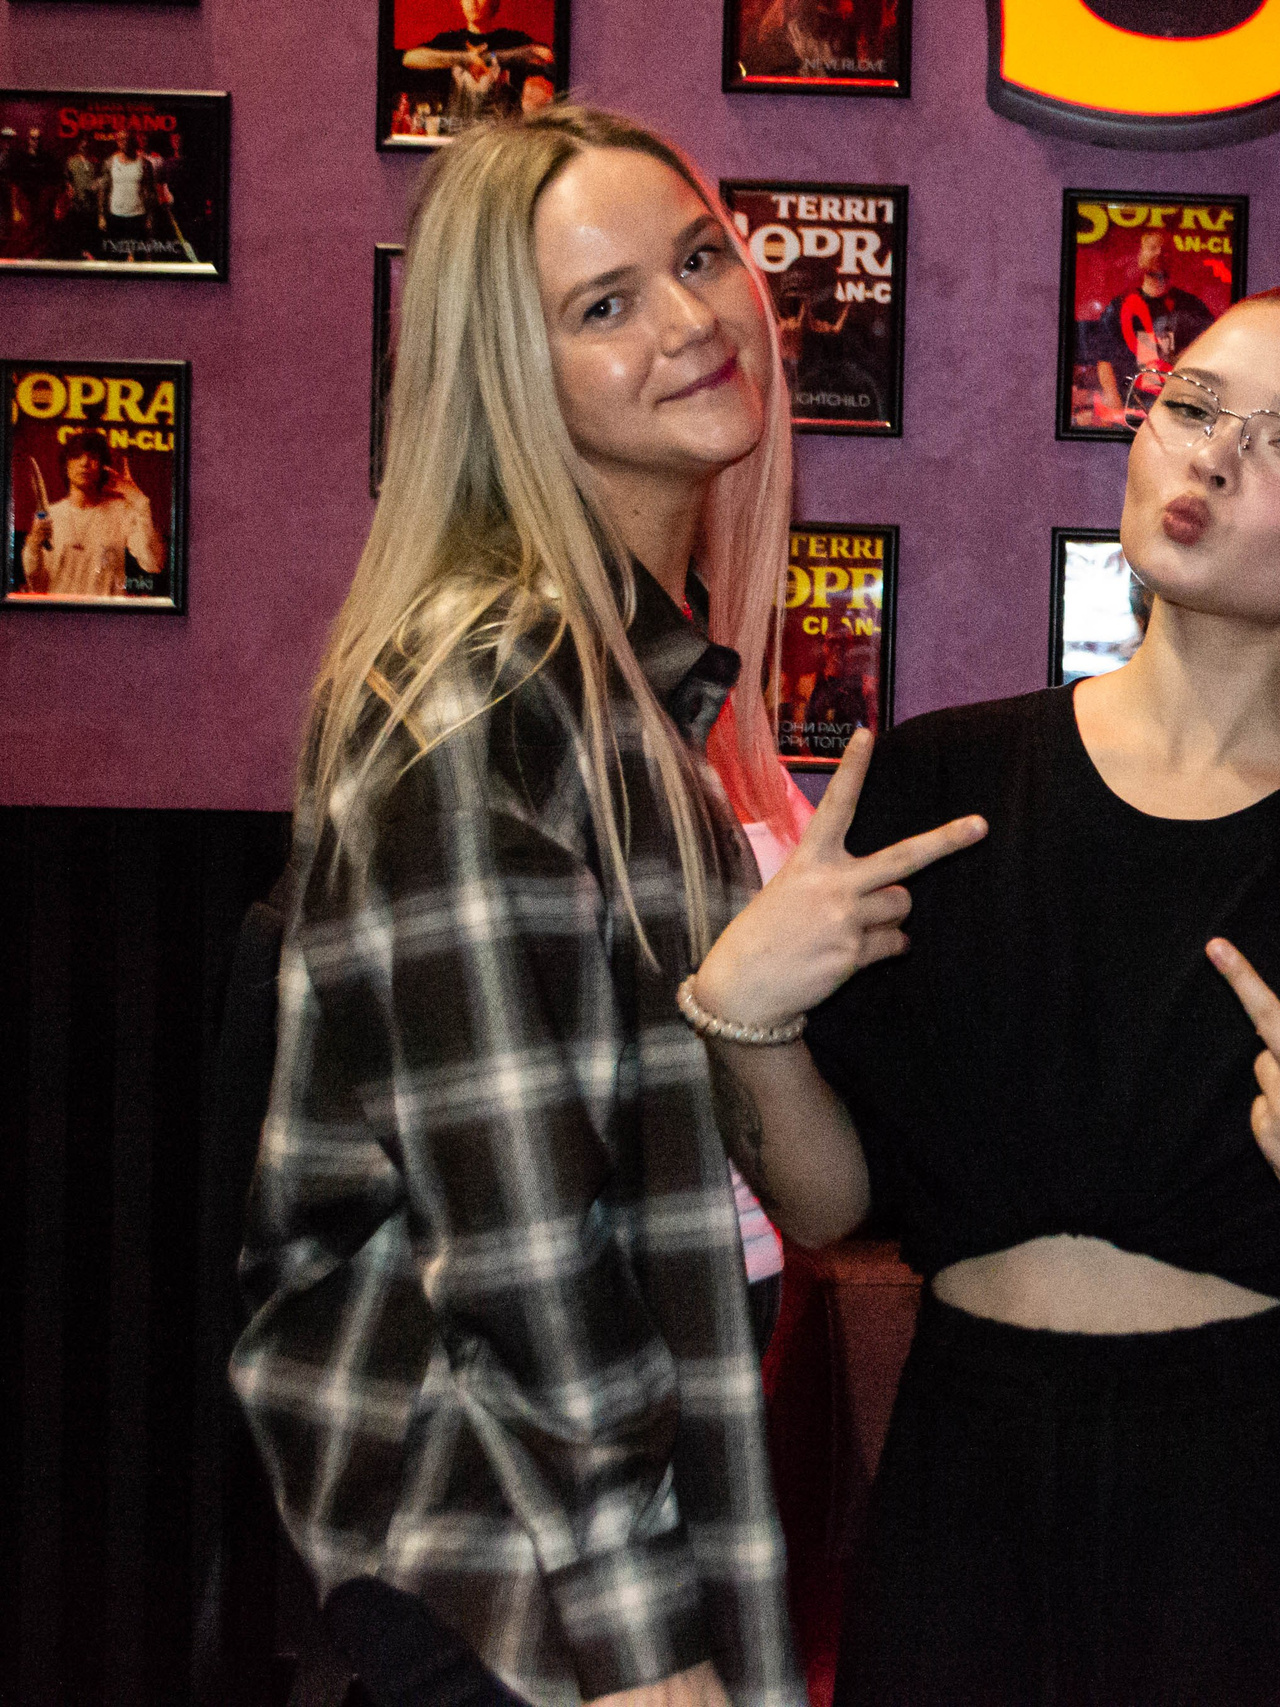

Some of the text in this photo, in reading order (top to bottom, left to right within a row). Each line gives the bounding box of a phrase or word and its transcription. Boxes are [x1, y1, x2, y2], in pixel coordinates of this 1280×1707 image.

[772, 195, 893, 224] TERRIT
[734, 212, 892, 277] OPR
[11, 371, 175, 426] OPRA
